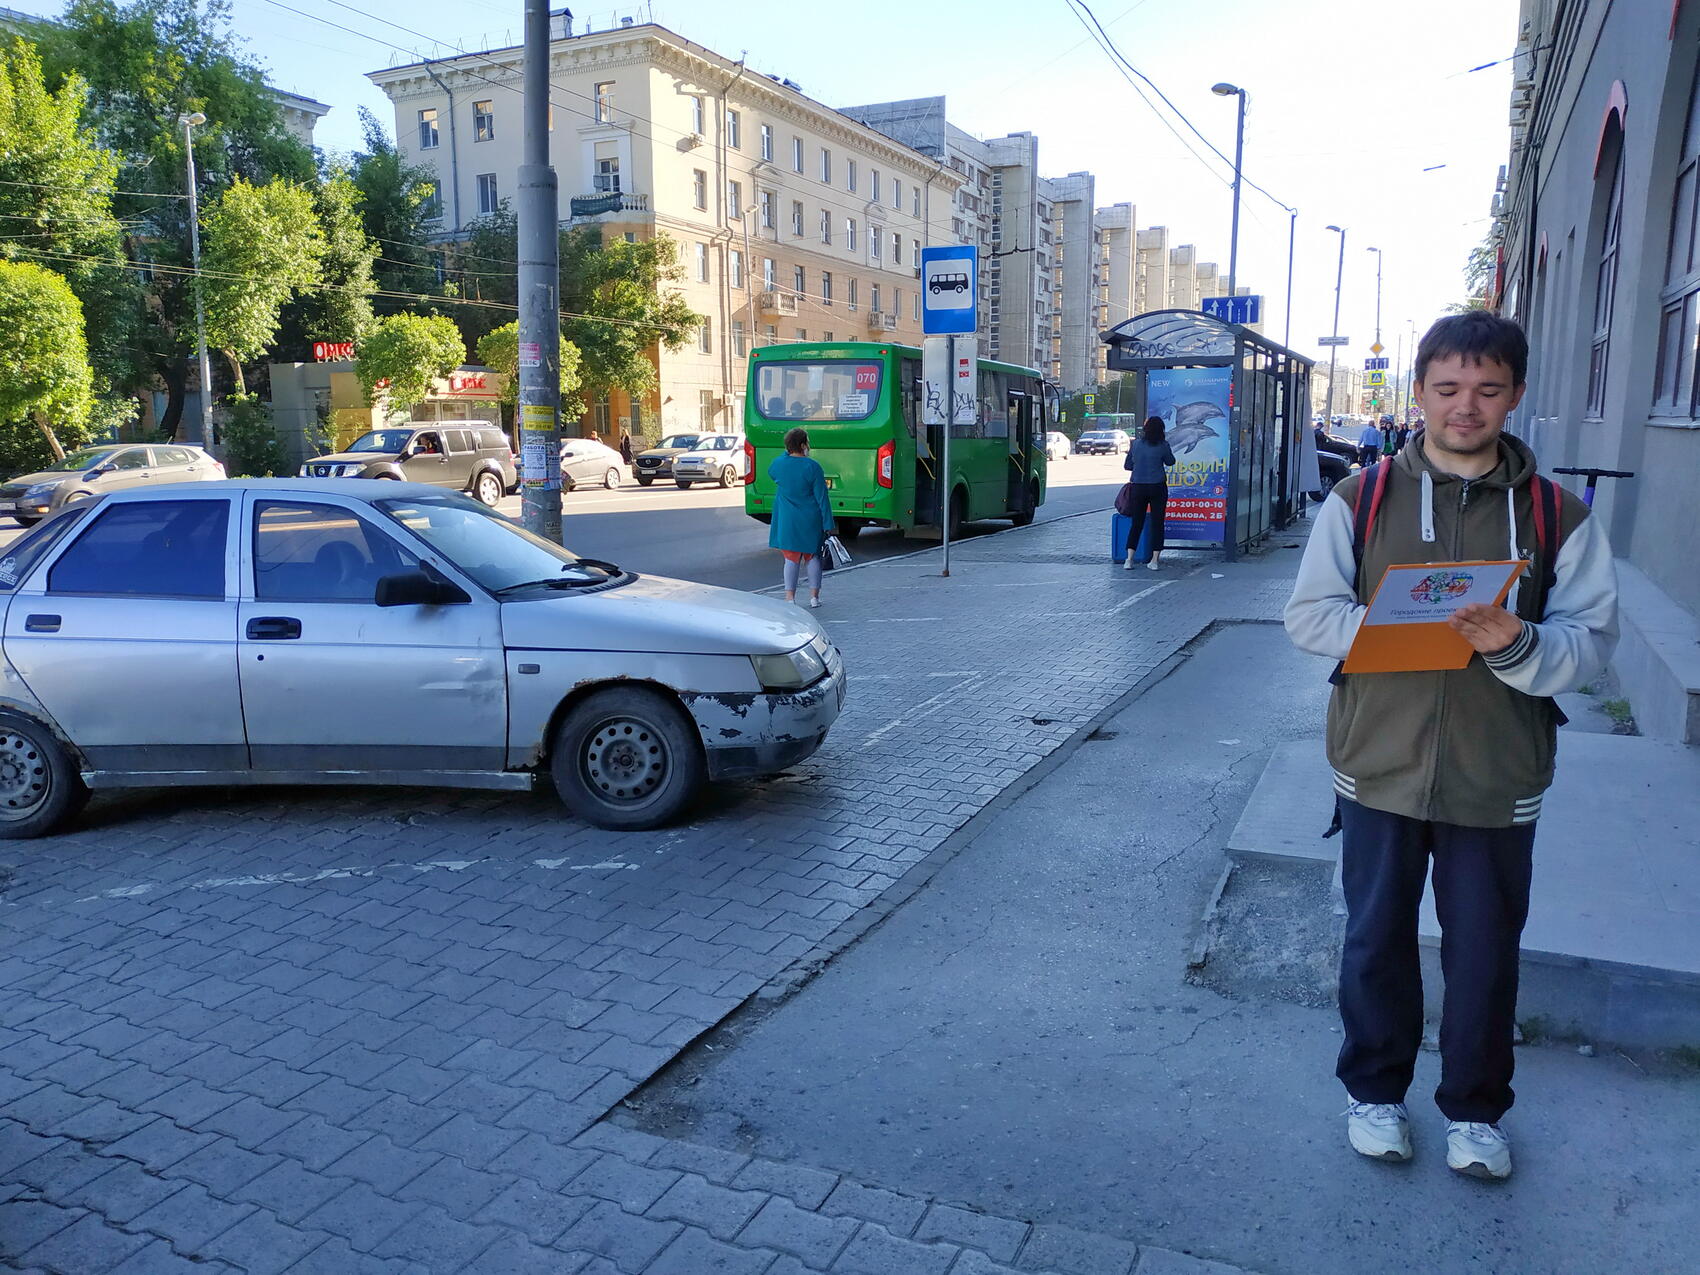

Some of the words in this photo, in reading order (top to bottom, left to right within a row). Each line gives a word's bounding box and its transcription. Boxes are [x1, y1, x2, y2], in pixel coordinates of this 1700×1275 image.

[857, 373, 876, 383] 070
[1167, 458, 1226, 473] ЛЬФИН
[1166, 473, 1208, 487] ШОУ
[1433, 607, 1457, 615] проек
